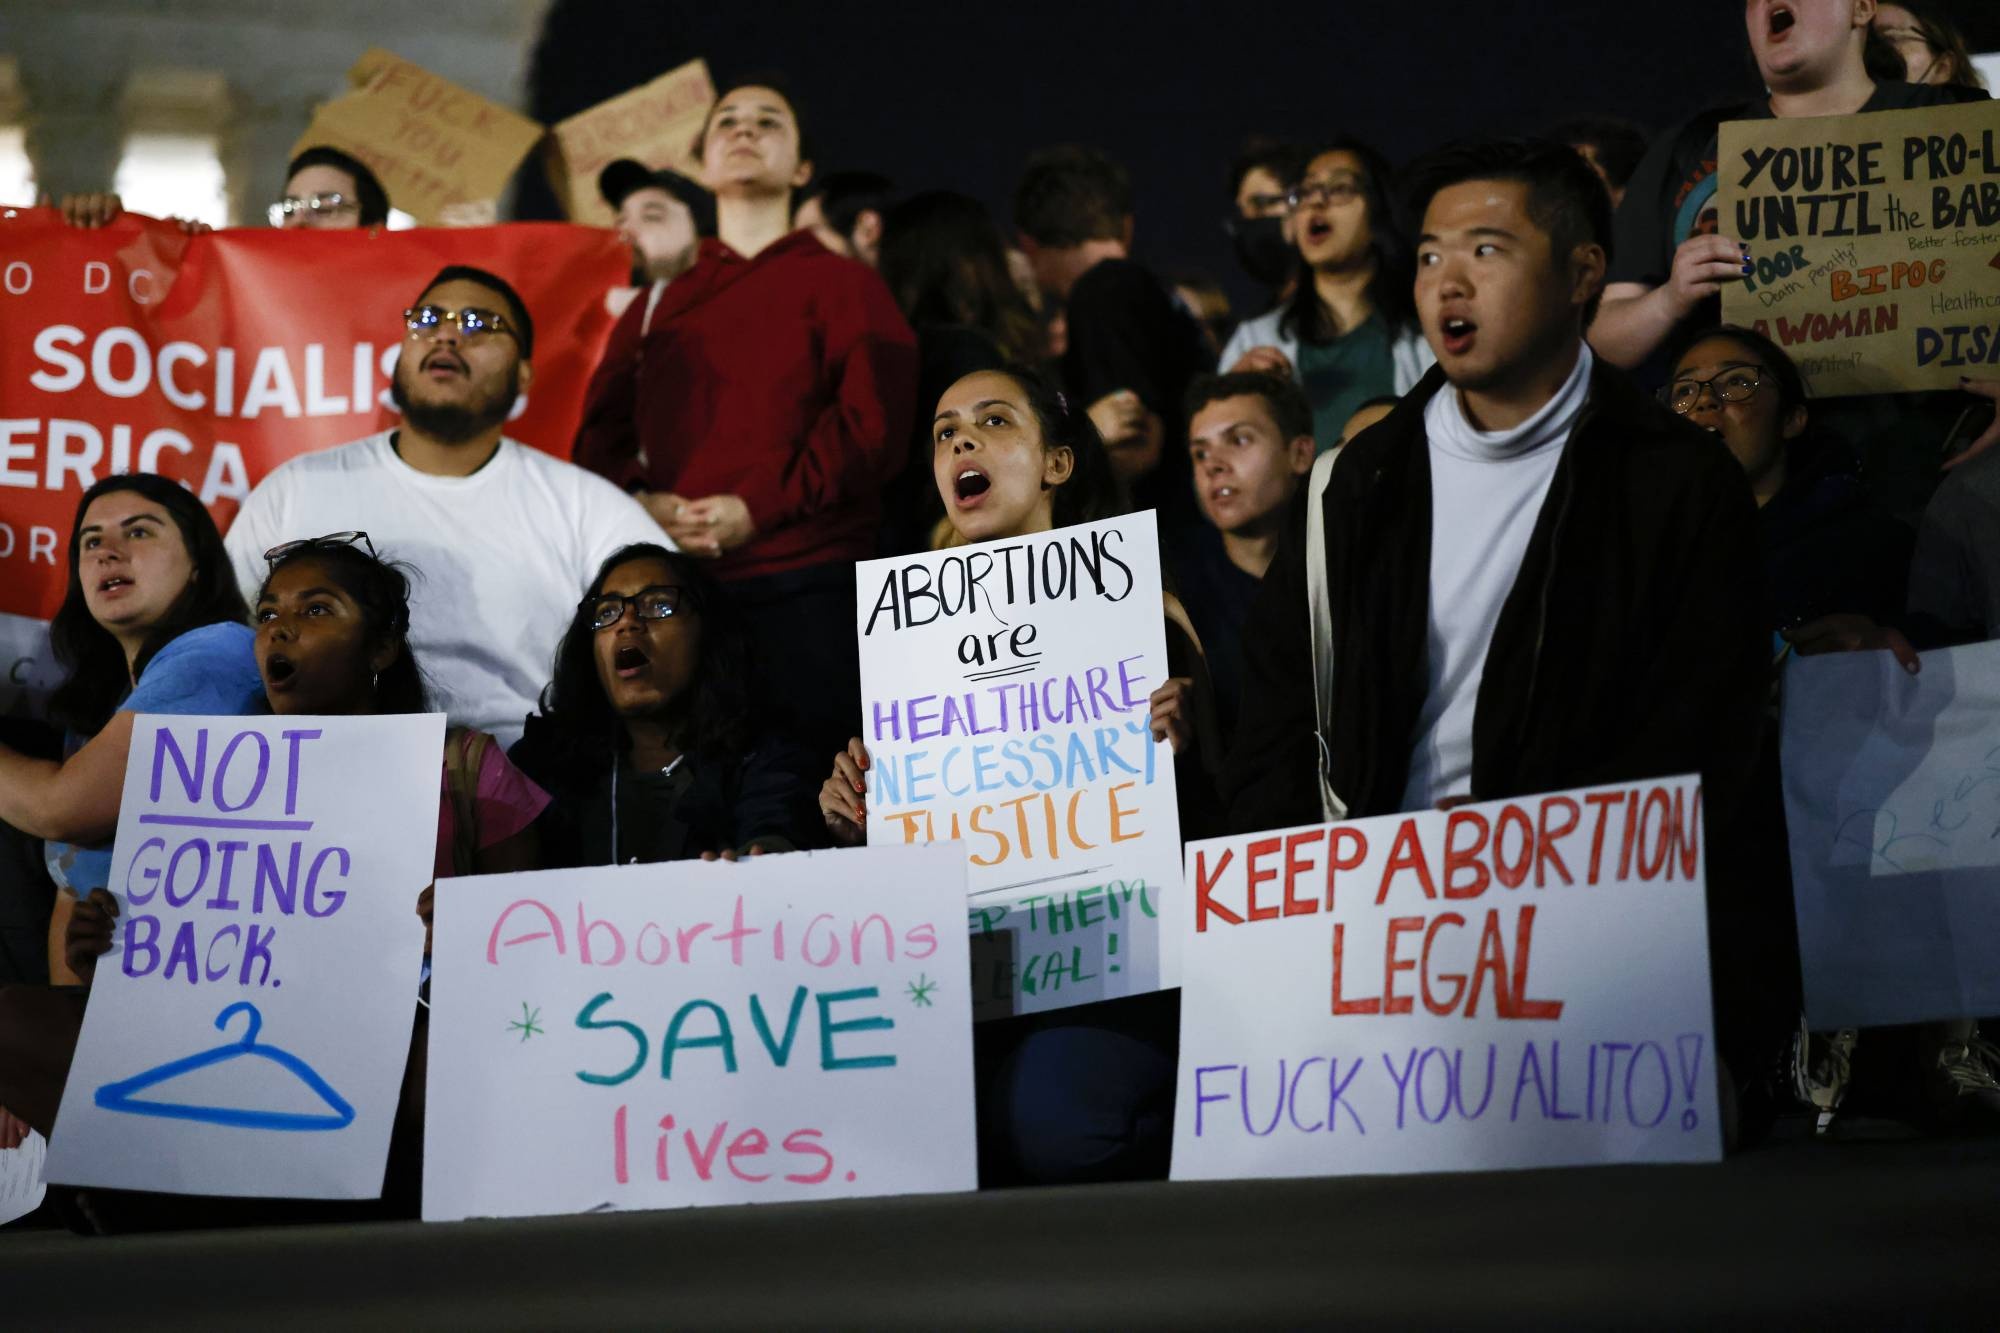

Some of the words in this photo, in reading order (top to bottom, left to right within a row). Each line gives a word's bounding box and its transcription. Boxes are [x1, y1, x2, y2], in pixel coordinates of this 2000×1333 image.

[1738, 141, 1886, 192] YOU'RE
[1903, 129, 2000, 181] PRO-L
[1736, 191, 1881, 241] UNTIL
[1883, 193, 1926, 232] the
[1932, 182, 2000, 230] BAB
[1907, 236, 1947, 251] Better
[84, 261, 153, 304] DC
[1743, 244, 1812, 294] POOR
[1757, 280, 1805, 309] Death
[1829, 258, 1947, 301] BIPOC
[1751, 317, 1772, 341] A
[1776, 303, 1899, 347] WOMAN
[30, 324, 402, 418] SOCIALI
[0, 417, 251, 506] ERICA
[865, 529, 1133, 636] ABORTIONS
[957, 623, 1043, 666] are
[873, 654, 1152, 743] HEALTHCARE
[149, 727, 323, 815] NOT
[874, 713, 1155, 806] NECESSARY
[884, 781, 1145, 866] JUSTICE
[1195, 825, 1369, 934] KEEP
[1375, 785, 1701, 905] ABORTION
[127, 837, 351, 918] GOING
[1019, 878, 1157, 935] THEM
[122, 914, 281, 988] BACK.
[487, 895, 938, 967] Abortions
[1331, 904, 1564, 1021] LEGAL
[575, 985, 897, 1086] SAVE
[1194, 1056, 1366, 1138] FUCK
[1382, 1043, 1496, 1131] YOU
[1510, 1032, 1703, 1132] ALITO!
[613, 1104, 857, 1185] lives.
